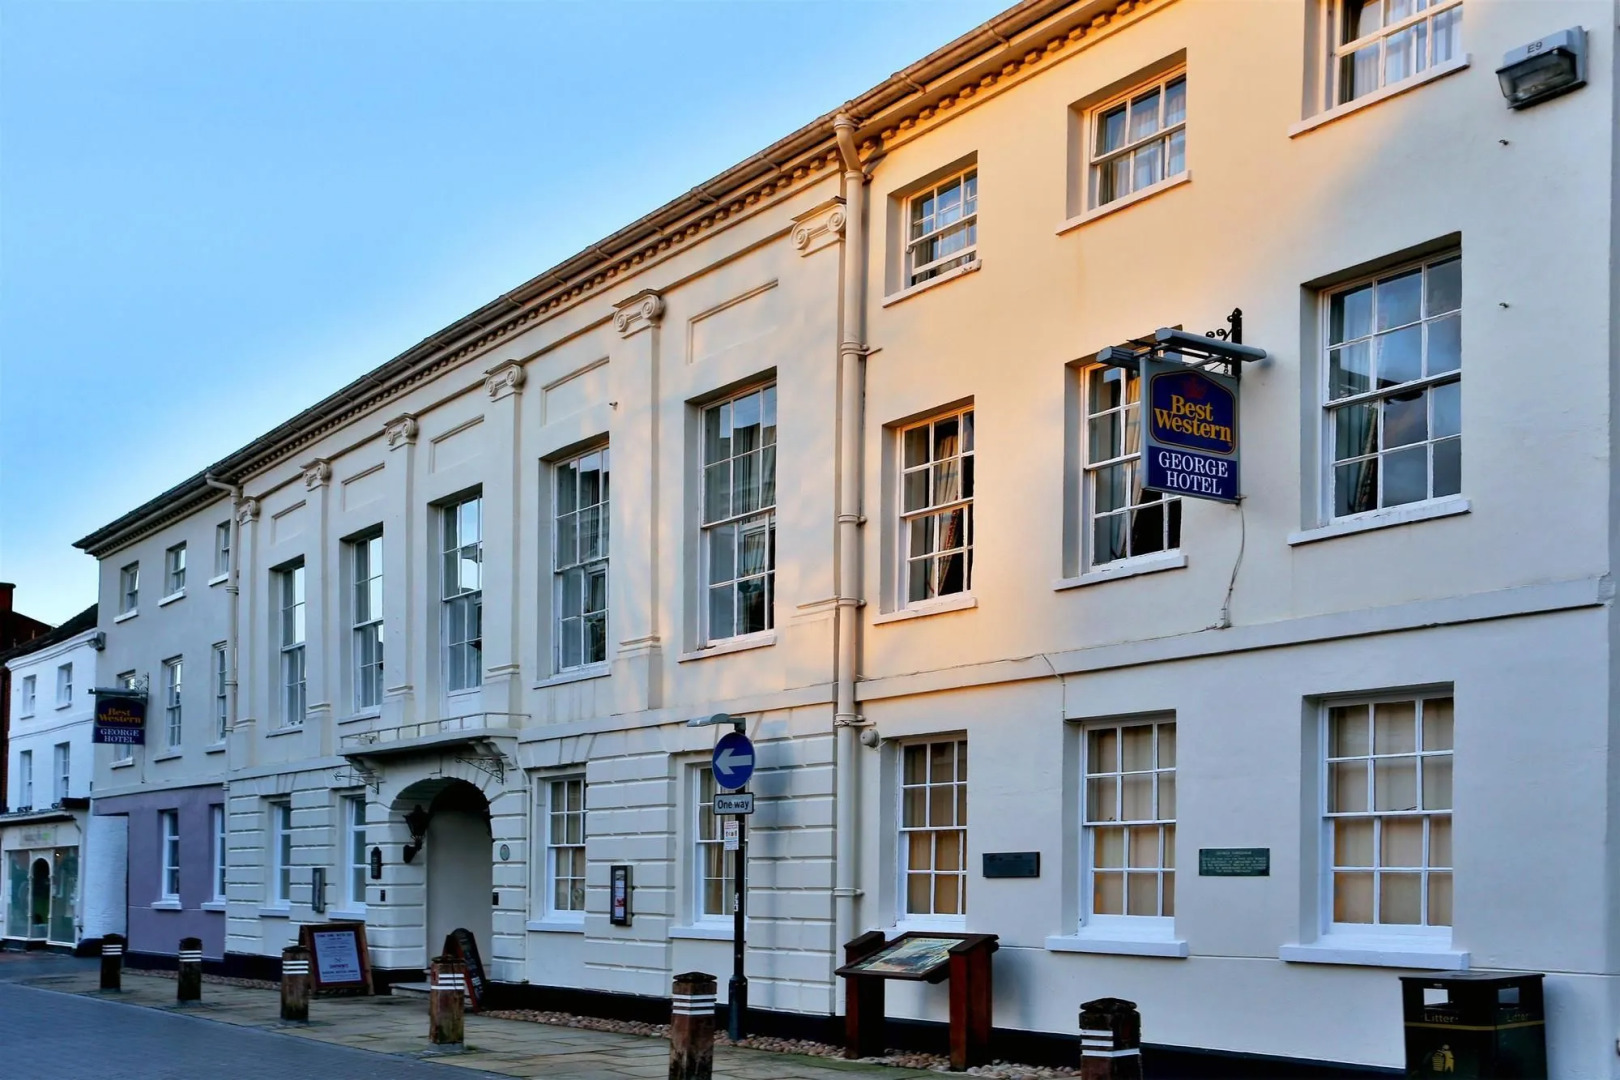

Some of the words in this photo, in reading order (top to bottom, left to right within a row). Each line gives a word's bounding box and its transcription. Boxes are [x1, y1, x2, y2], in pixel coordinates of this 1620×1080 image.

[1527, 41, 1543, 54] E9
[1171, 394, 1214, 421] Best
[1154, 407, 1232, 442] Western
[1158, 451, 1228, 477] GEORGE
[1166, 470, 1222, 494] HOTEL
[108, 707, 130, 716] Best
[98, 713, 141, 724] Western
[100, 728, 139, 737] GEORGE
[104, 735, 136, 743] HOTEL
[717, 799, 733, 809] One
[734, 800, 750, 811] way
[1424, 1011, 1456, 1023] Litter
